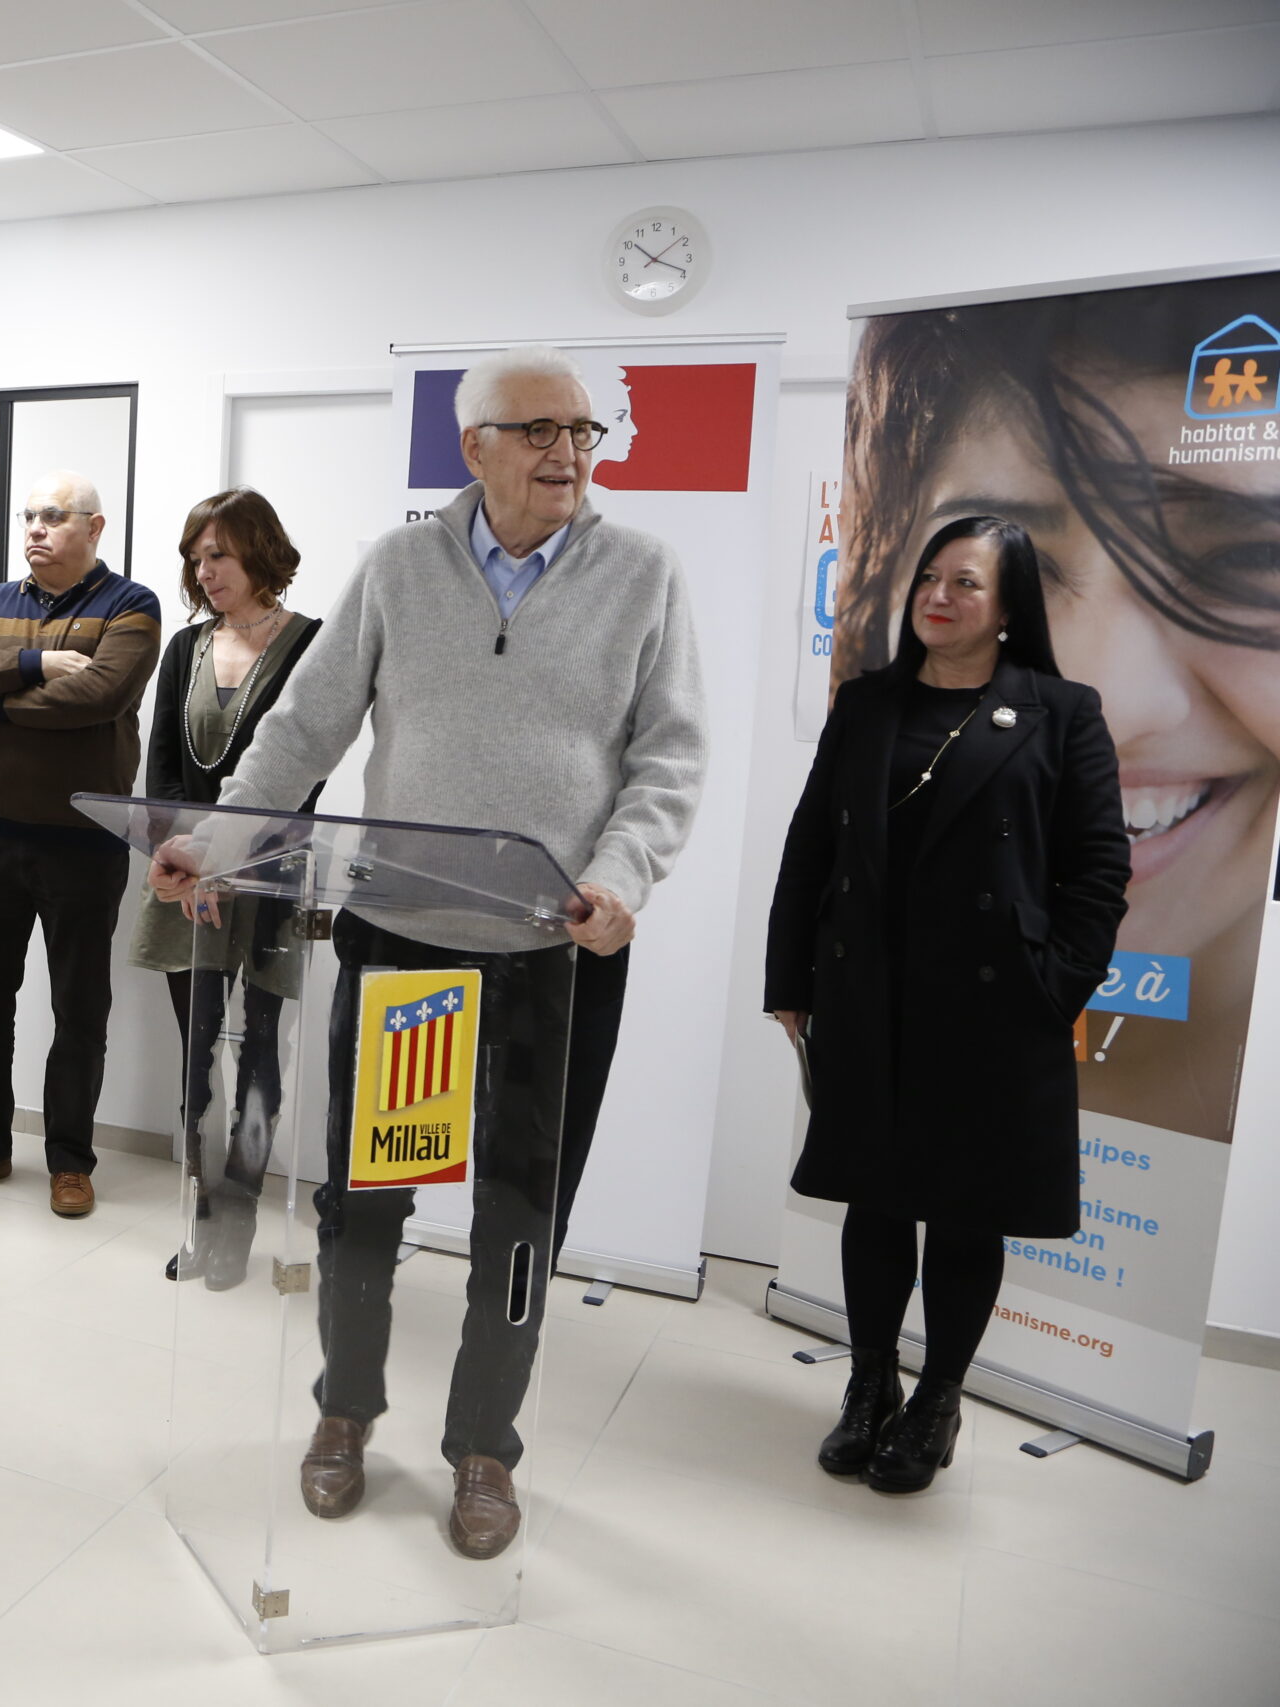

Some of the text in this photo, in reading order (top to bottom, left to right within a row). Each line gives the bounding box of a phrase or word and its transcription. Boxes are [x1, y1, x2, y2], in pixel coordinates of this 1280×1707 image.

[651, 222, 662, 232] 12
[671, 227, 676, 236] 1
[635, 229, 645, 238] 11
[623, 240, 633, 250] 10
[682, 237, 689, 247] 2
[618, 257, 625, 267] 9
[686, 253, 693, 264] 3
[622, 273, 629, 283] 8
[680, 270, 687, 280] 4
[650, 287, 657, 298] 6
[668, 282, 675, 293] 5
[1180, 420, 1279, 445] habitat &
[1135, 961, 1171, 1003] à
[1094, 1015, 1125, 1062] !
[420, 1122, 451, 1135] VILLE DE
[370, 1124, 450, 1163] Millau
[1115, 1267, 1125, 1287] !
